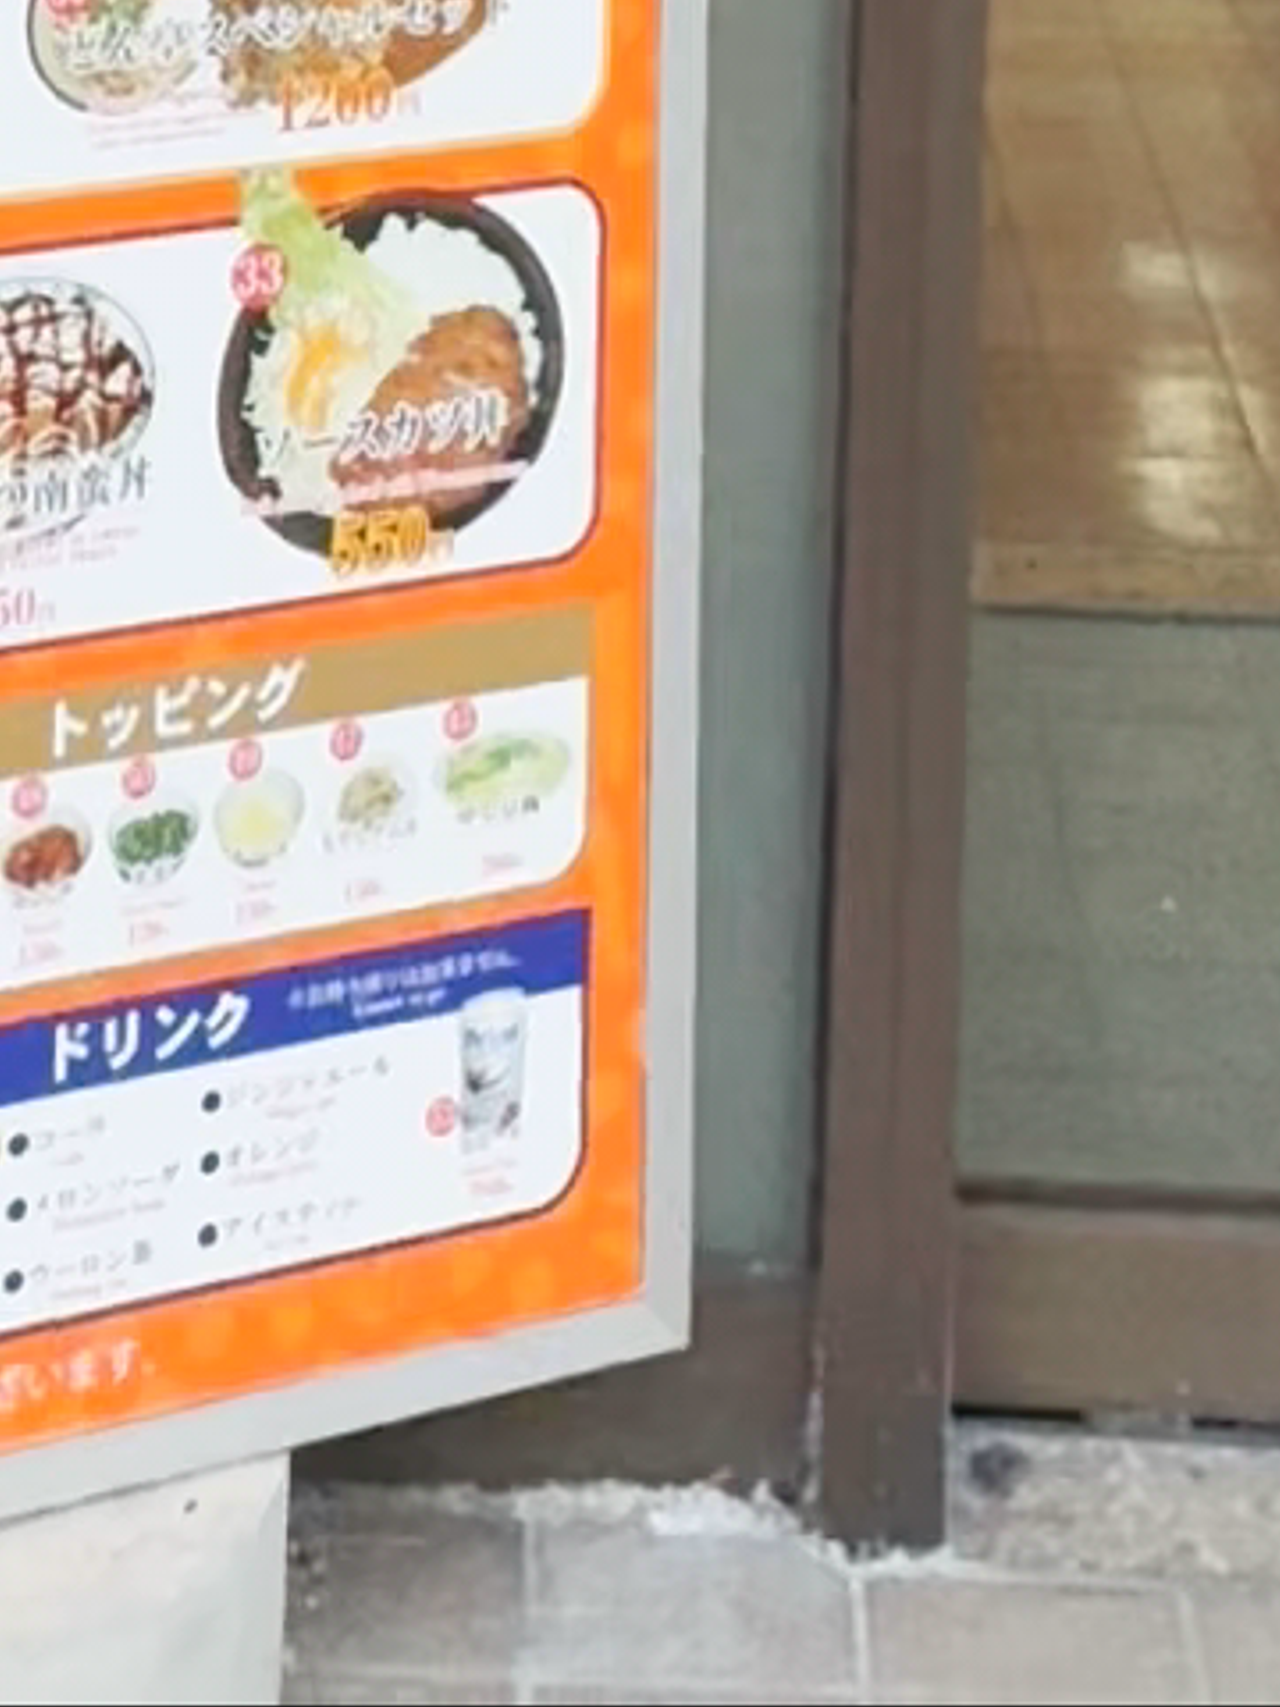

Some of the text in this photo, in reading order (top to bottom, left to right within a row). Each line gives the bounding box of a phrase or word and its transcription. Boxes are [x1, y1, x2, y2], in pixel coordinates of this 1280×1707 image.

[51, 658, 308, 760] トッピング
[52, 991, 251, 1083] ドリンク
